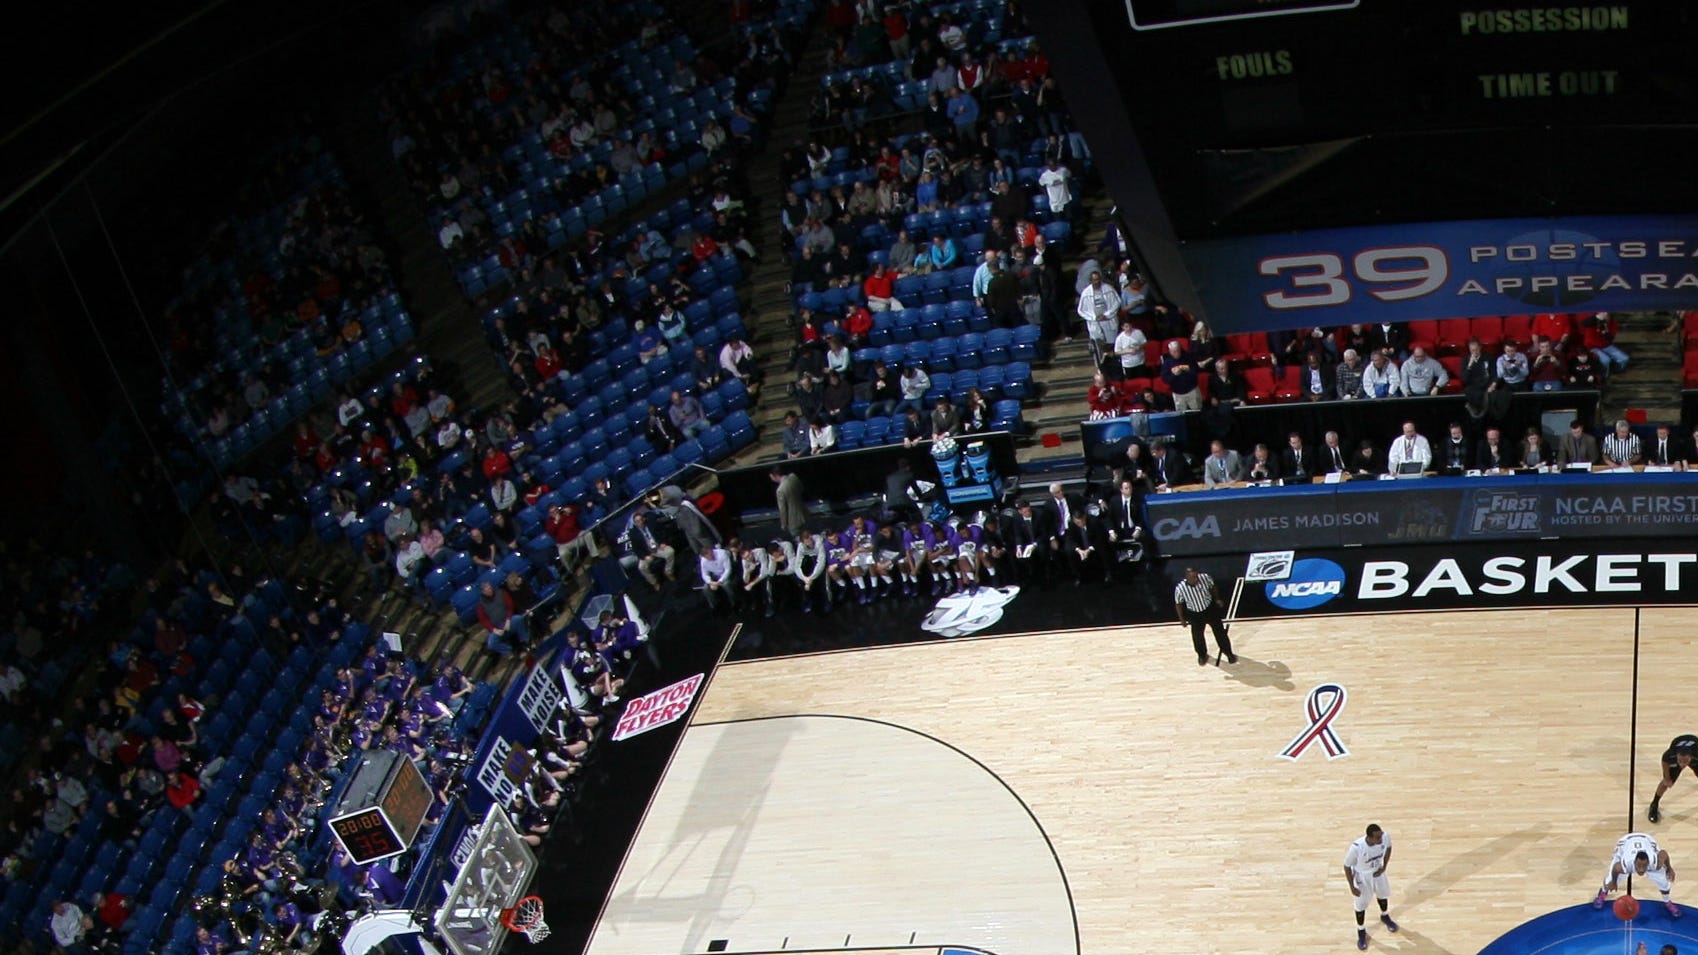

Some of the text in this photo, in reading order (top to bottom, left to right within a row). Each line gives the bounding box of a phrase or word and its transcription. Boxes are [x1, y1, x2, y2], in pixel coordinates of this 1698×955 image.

[1461, 7, 1629, 36] POSSESSION
[1216, 50, 1294, 81] FOULS
[1479, 69, 1619, 99] TIME OUT
[1258, 242, 1448, 311] 39
[1491, 495, 1537, 511] FIRST
[1556, 497, 1626, 514] NCAA
[1152, 515, 1222, 541] CAA
[1232, 512, 1379, 532] JAMES MADISON
[1551, 515, 1601, 525] HOSTED
[1606, 514, 1621, 524] BY
[1626, 514, 1648, 524] THE
[1271, 581, 1341, 598] NCAA
[520, 669, 547, 713] MAKE
[622, 676, 701, 719] DAYTON
[531, 683, 560, 731] NOISE
[614, 697, 690, 738] FLYERS
[481, 741, 510, 788] MAKE
